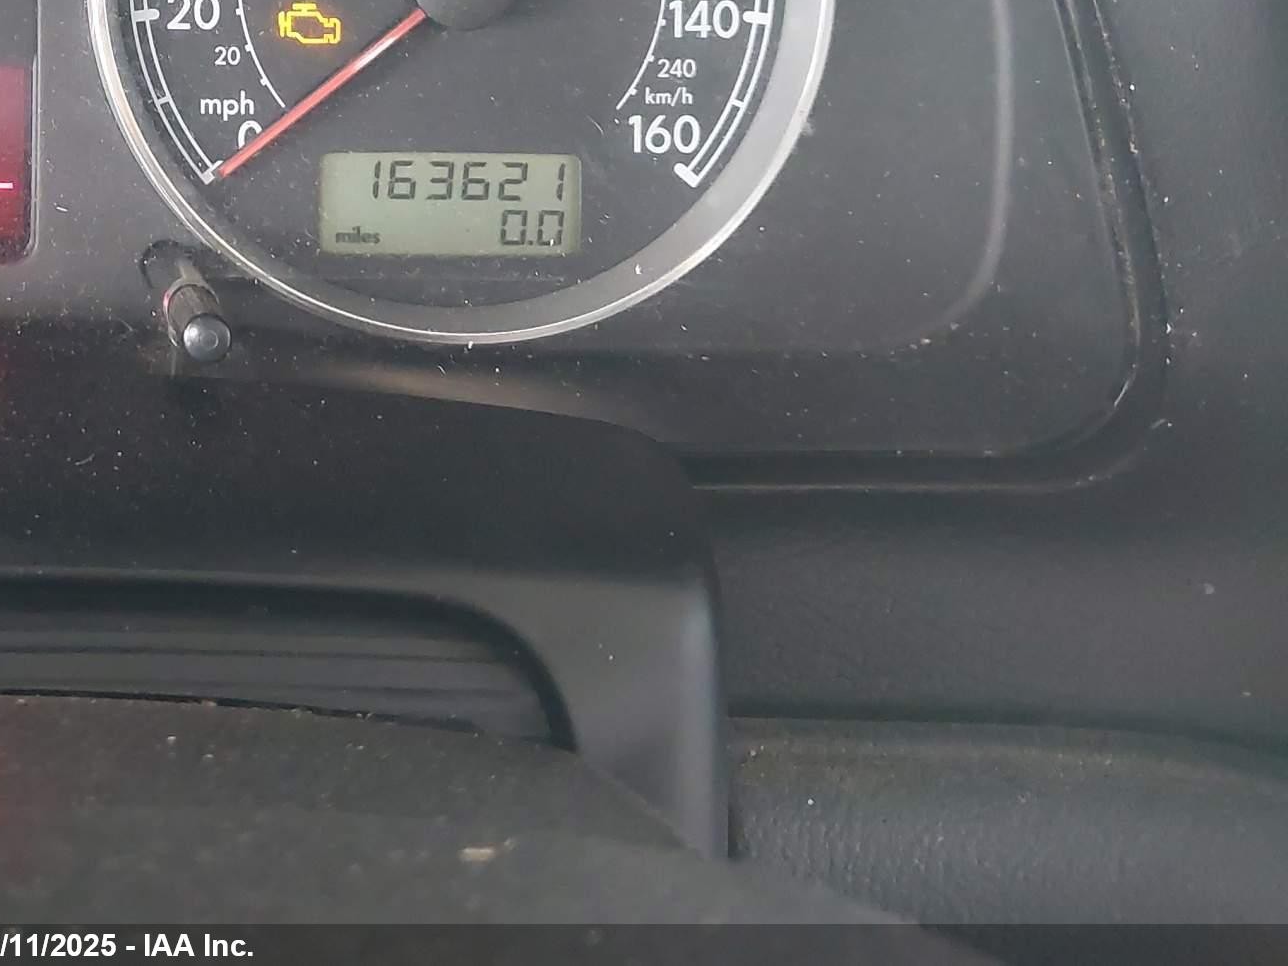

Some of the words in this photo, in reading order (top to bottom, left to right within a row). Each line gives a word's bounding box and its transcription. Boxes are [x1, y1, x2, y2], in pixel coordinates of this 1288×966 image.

[669, 0, 740, 39] 140
[214, 46, 241, 66] 20
[657, 58, 697, 78] 240
[200, 89, 255, 121] mph
[645, 86, 693, 107] km/h
[628, 114, 700, 156] 160
[372, 160, 566, 201] 163621
[335, 225, 381, 245] miles
[500, 209, 565, 246] 0.0
